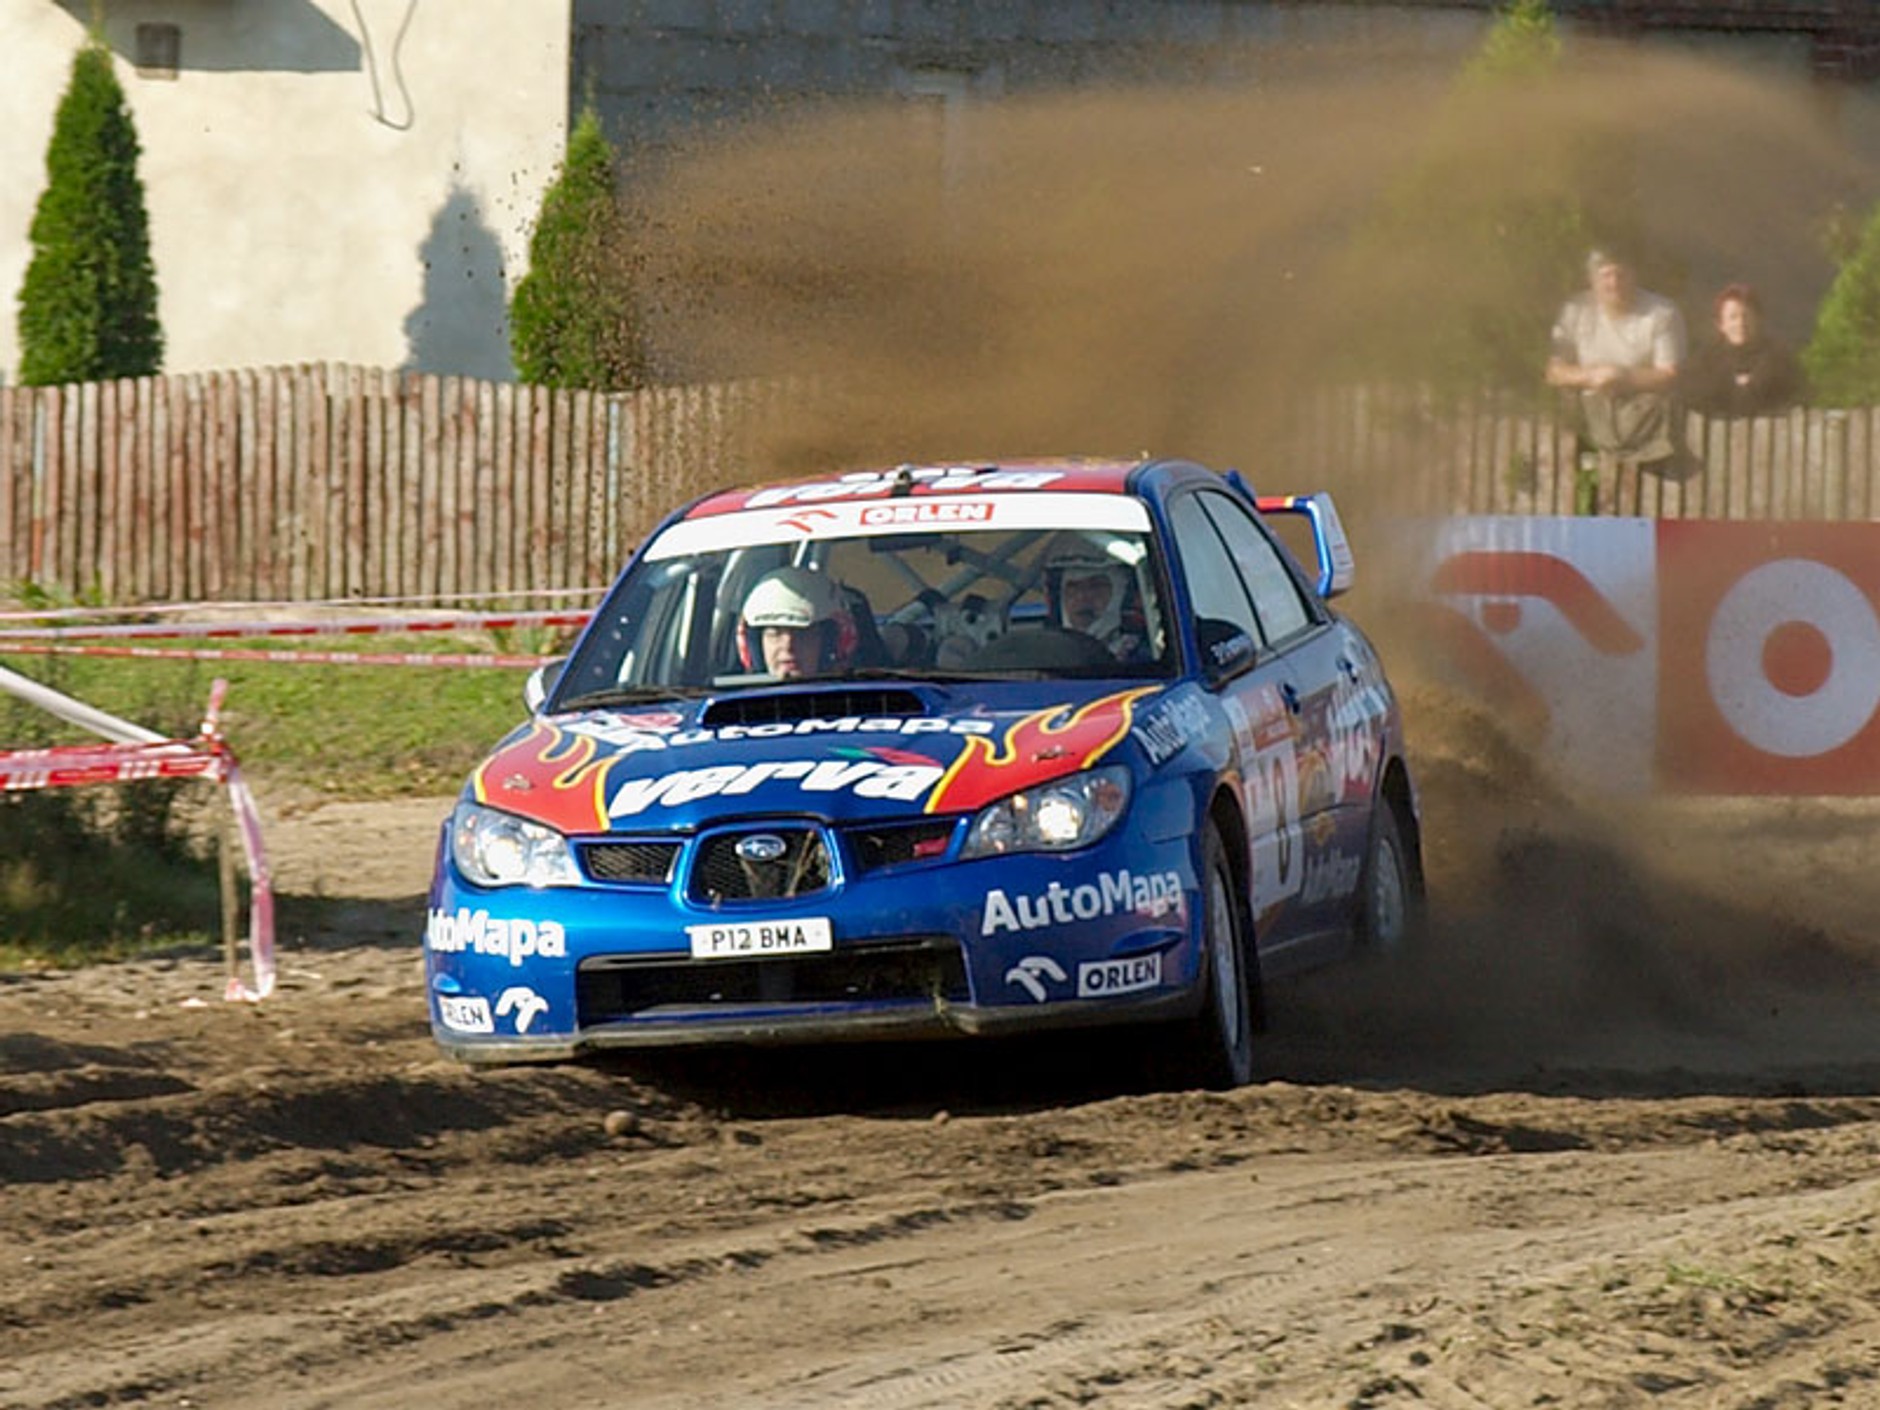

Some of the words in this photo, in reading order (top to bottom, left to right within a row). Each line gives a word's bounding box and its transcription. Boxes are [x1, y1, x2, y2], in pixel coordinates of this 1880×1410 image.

[864, 503, 987, 524] ORLEN
[1707, 557, 1880, 757] O
[614, 716, 994, 757] AutoMapa
[608, 760, 945, 819] verva
[981, 869, 1183, 937] AutoMapa
[711, 928, 752, 951] P12
[760, 926, 807, 949] BMA
[1086, 958, 1157, 990] ORLEN
